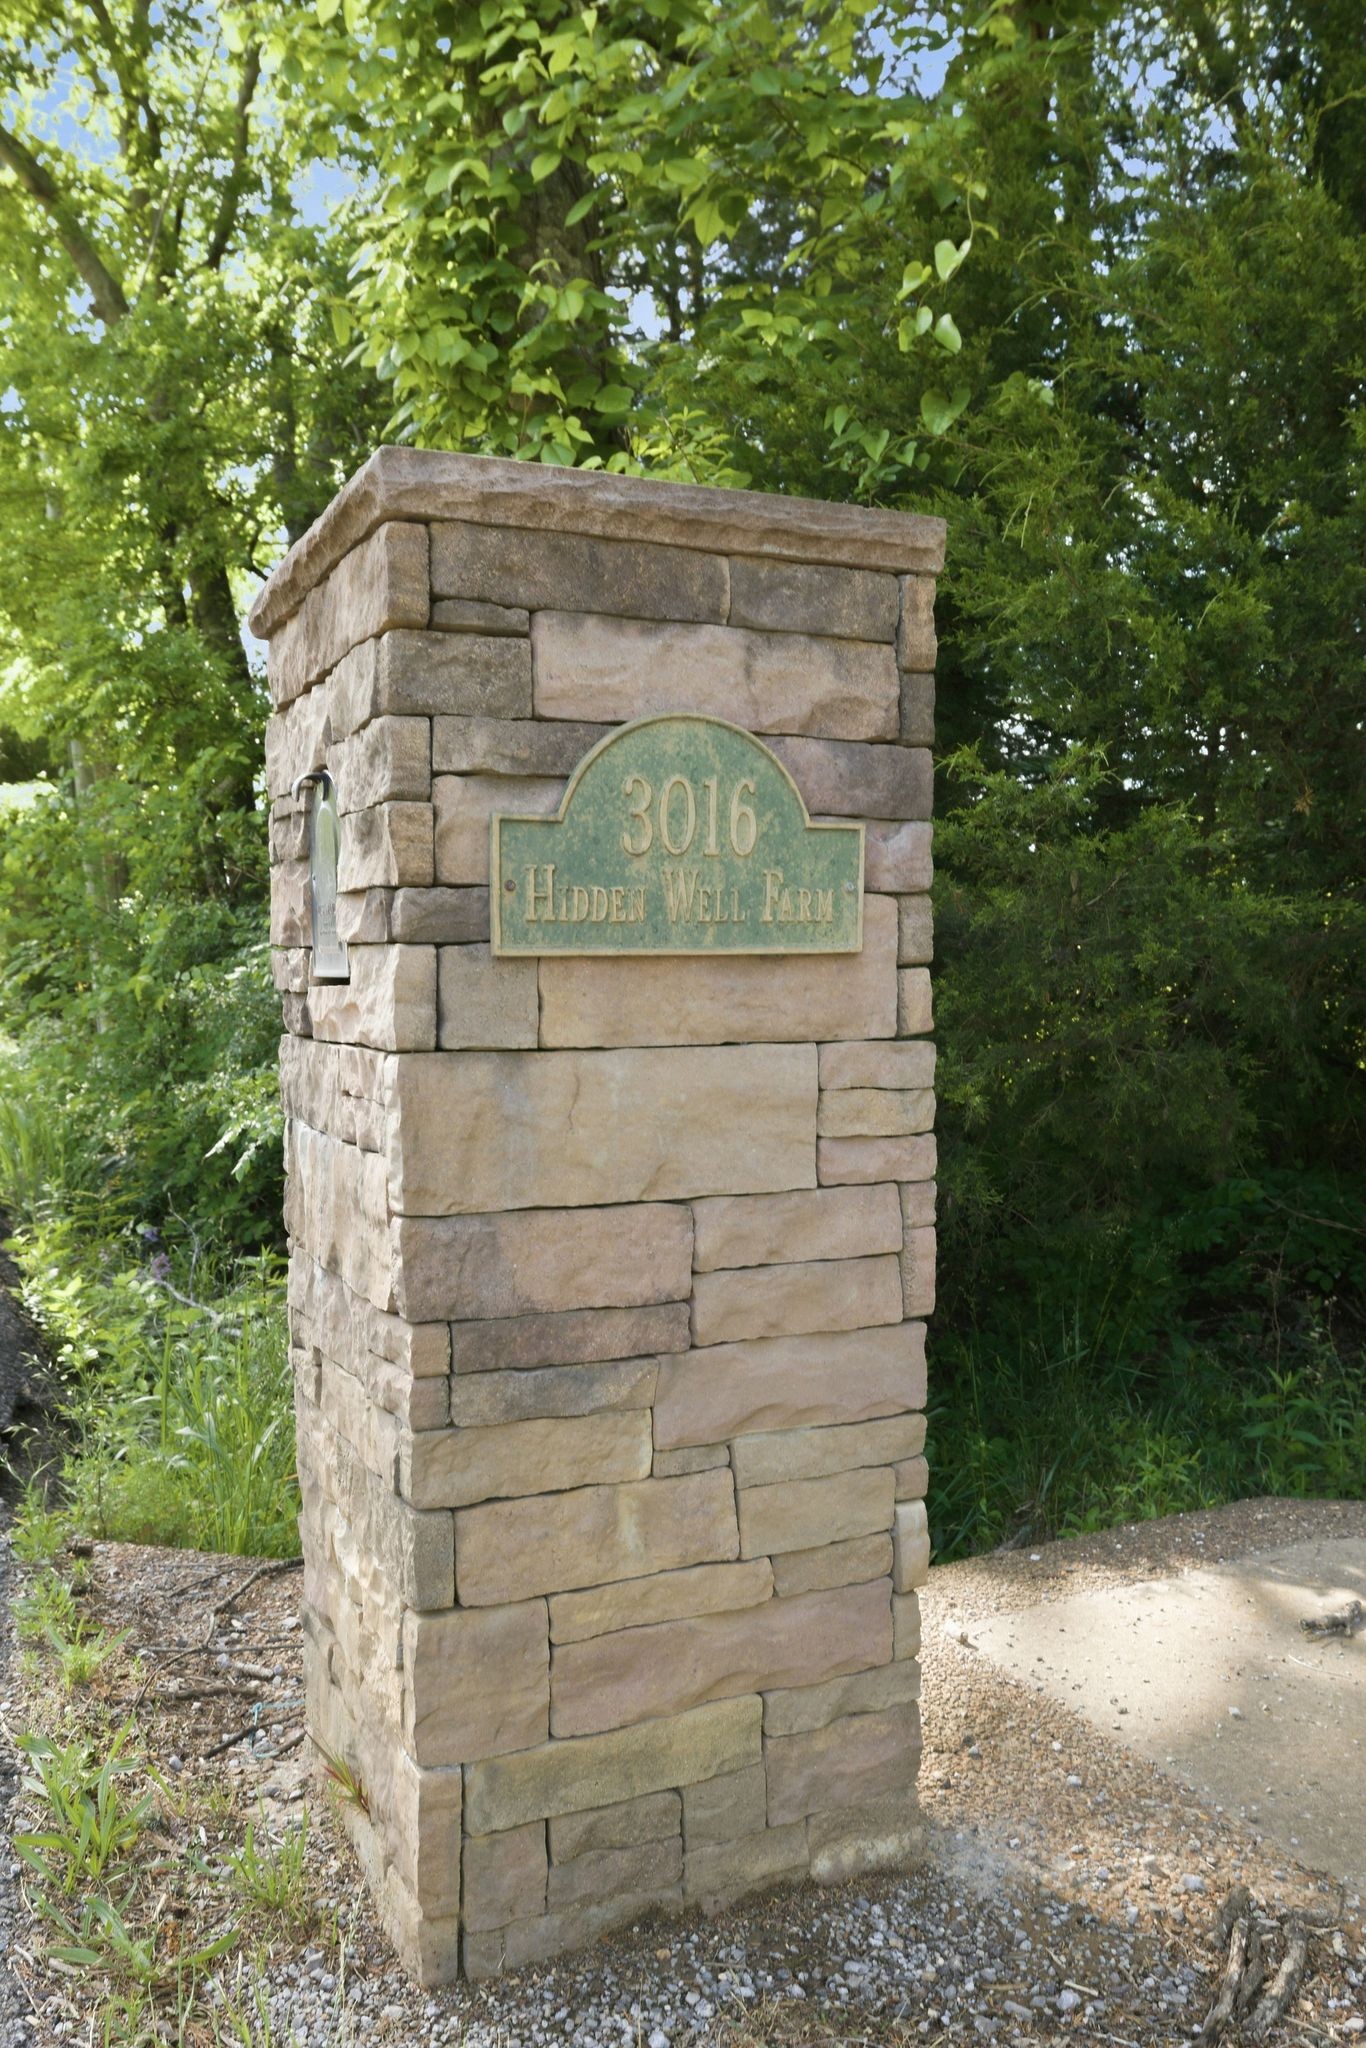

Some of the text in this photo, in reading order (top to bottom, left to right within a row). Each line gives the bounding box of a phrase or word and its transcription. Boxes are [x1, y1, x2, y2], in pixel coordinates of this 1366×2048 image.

[621, 774, 757, 857] 3016
[524, 863, 835, 923] HIDDEN WELL FARM
